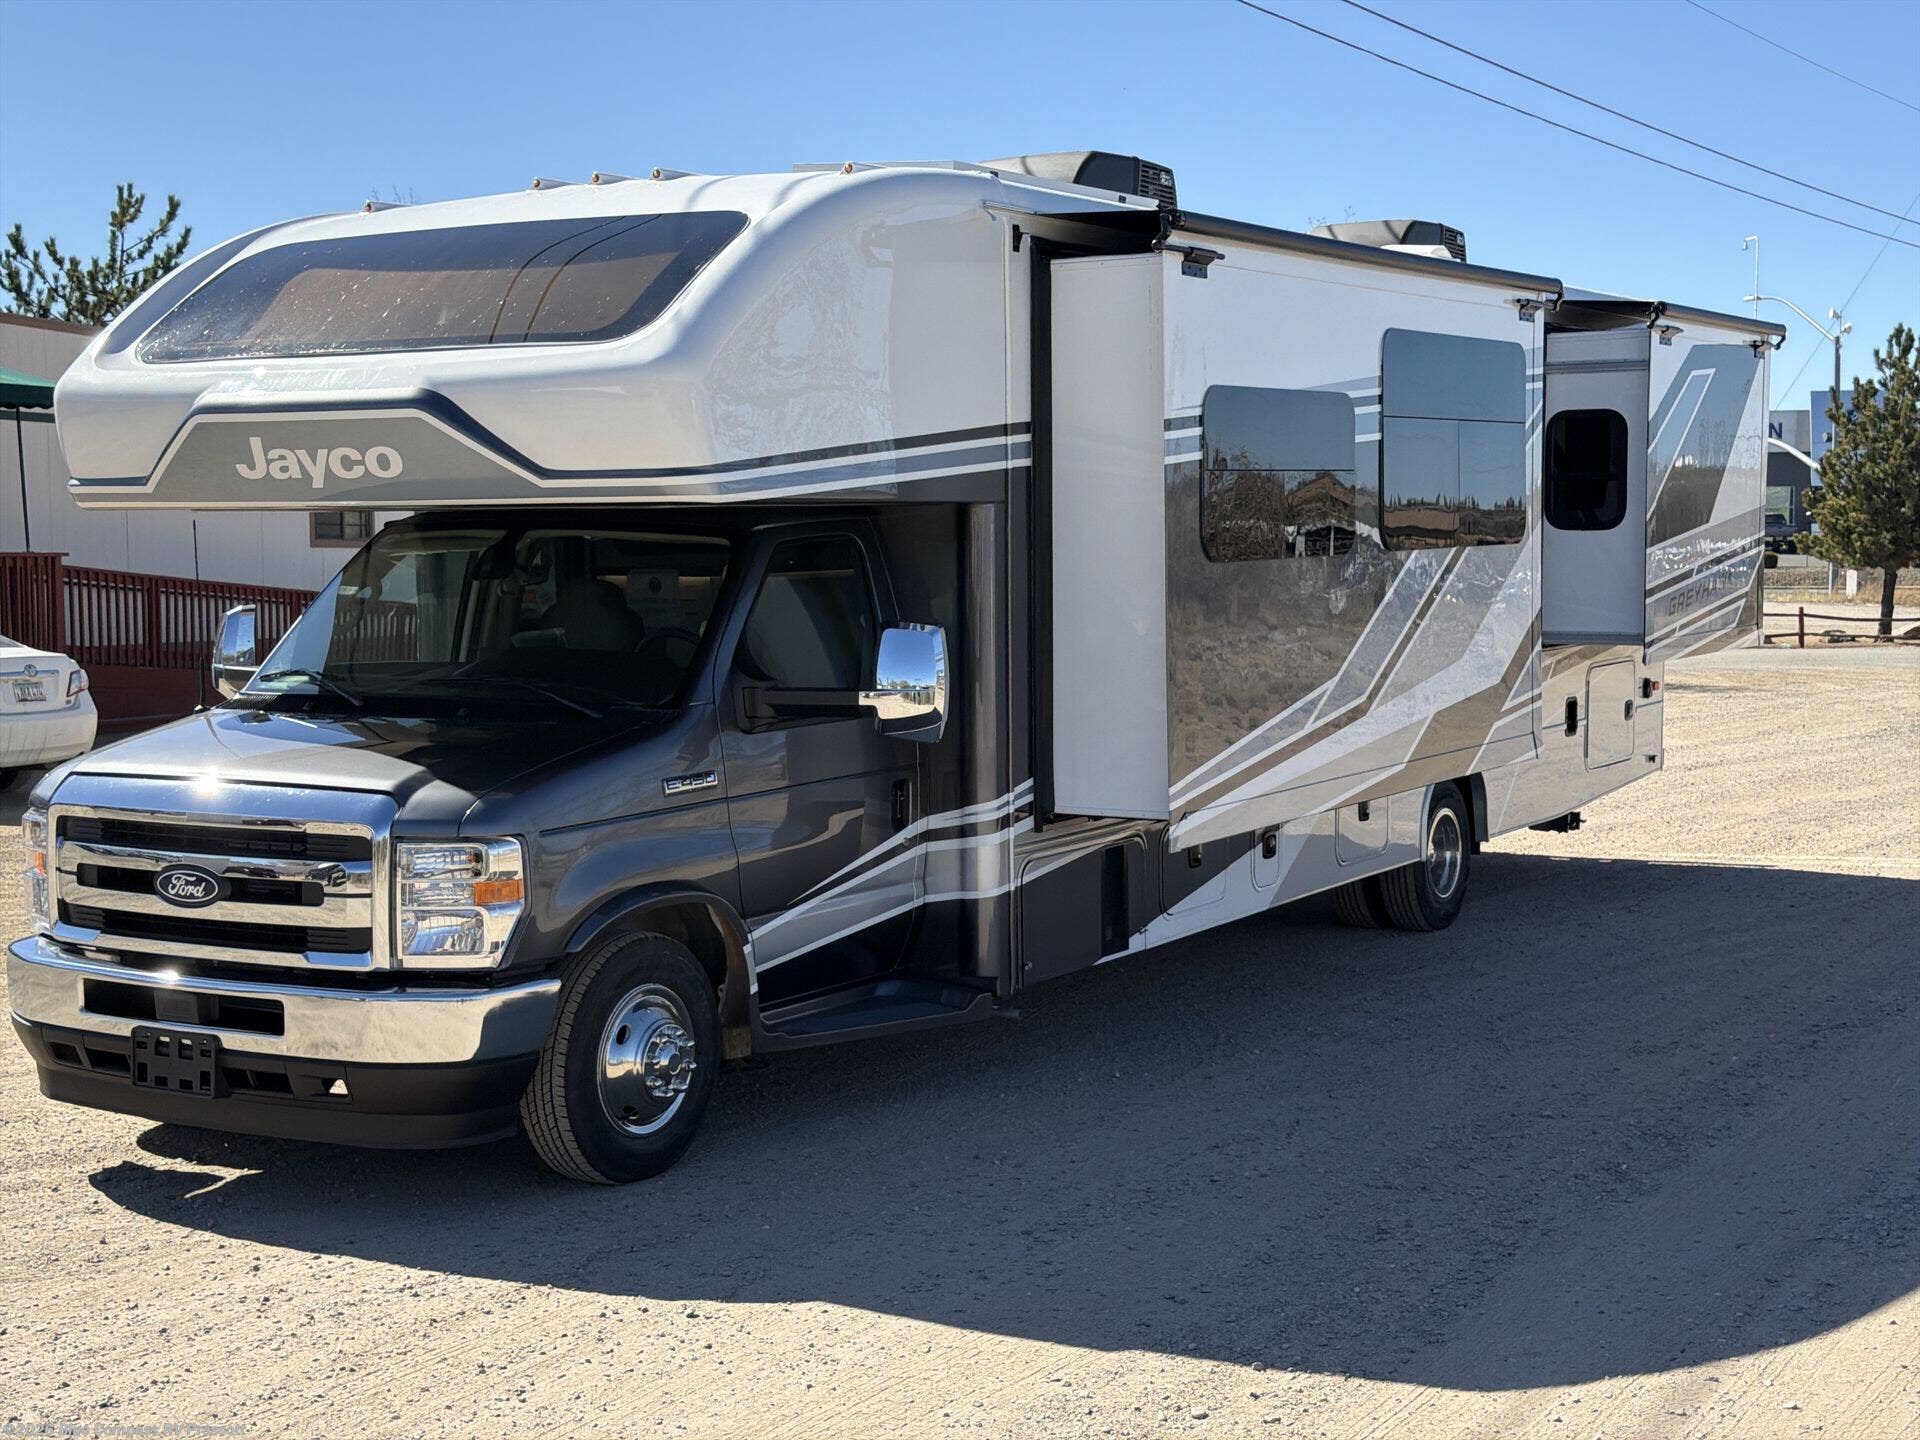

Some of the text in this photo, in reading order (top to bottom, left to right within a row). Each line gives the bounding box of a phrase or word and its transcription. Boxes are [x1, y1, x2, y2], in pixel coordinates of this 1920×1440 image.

[235, 436, 403, 489] Jayco
[1669, 571, 1733, 616] GREYHAWK
[168, 874, 206, 897] Ford
